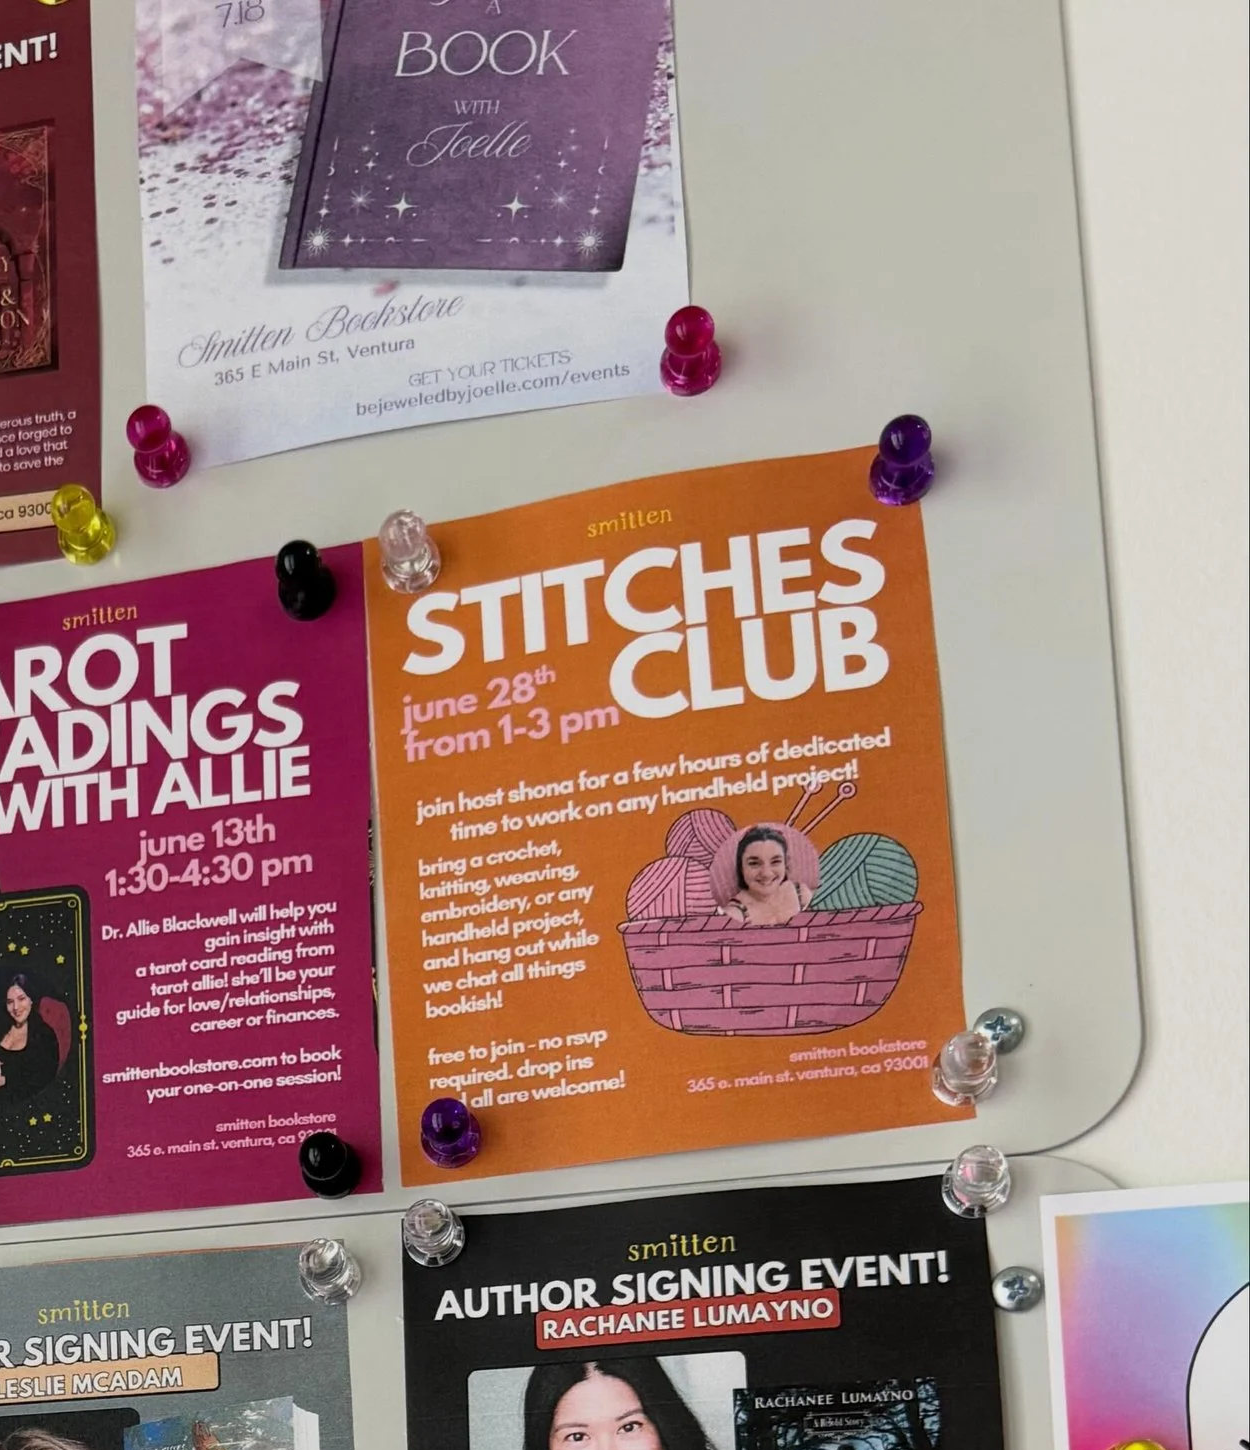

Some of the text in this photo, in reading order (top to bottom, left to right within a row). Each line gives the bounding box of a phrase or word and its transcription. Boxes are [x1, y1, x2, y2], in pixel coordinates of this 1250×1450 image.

[216, 1, 266, 28] 7.18
[395, 29, 577, 77] BOOK
[454, 99, 499, 115] WITH
[406, 119, 534, 167] Joelle
[178, 294, 466, 369] Smitten Bookstore
[214, 338, 415, 386] 365 E Main St, Ventura
[356, 362, 630, 416] bejeweledbyjoelle.com/events
[403, 518, 886, 675] STITCHES
[609, 606, 890, 719] CLUB
[401, 666, 556, 734] june 28th
[151, 745, 311, 814] ALLIE
[416, 728, 892, 824] join host shona for a few hours of dedicated
[138, 813, 276, 864] june 13th
[104, 851, 313, 897] 1:30-4:30 pm
[102, 900, 337, 940] Dr. Allie Blackwell will help you
[627, 1233, 736, 1262] smitten
[542, 1299, 834, 1339] RACHANEE LUMAYNO
[71, 1367, 183, 1394] MCADAM
